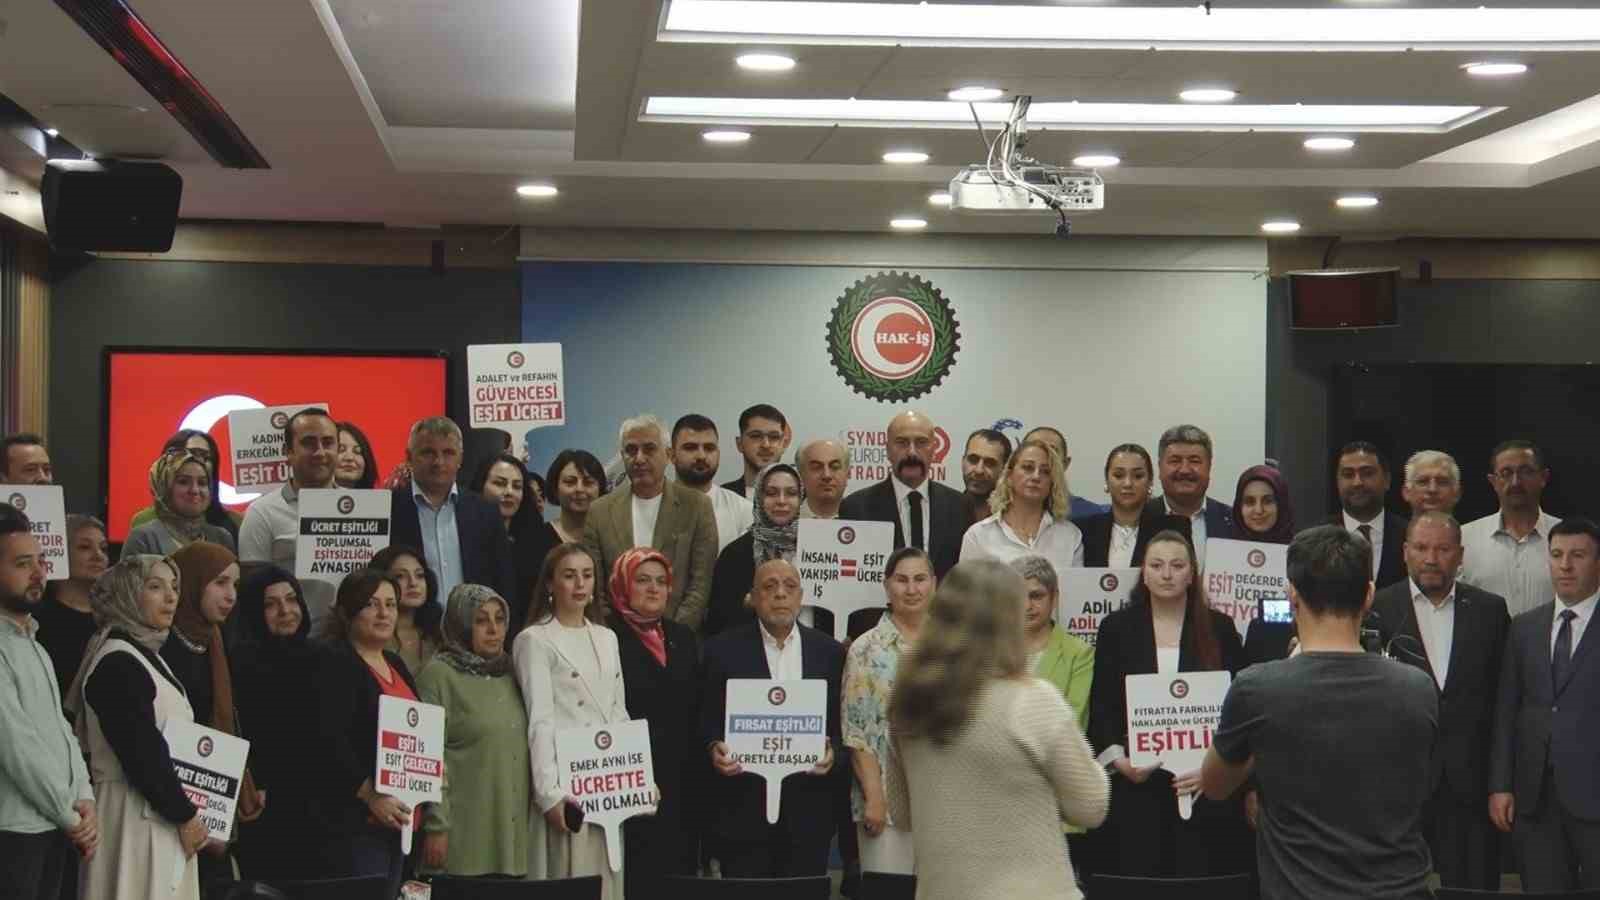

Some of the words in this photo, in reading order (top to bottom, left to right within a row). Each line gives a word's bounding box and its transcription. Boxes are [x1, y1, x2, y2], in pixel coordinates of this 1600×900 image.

[876, 331, 929, 346] HAK-İŞ
[476, 374, 507, 383] ADALET
[476, 383, 557, 401] GÜVENCESİ
[511, 403, 560, 420] ÜCRET
[237, 446, 279, 459] ERKEĞİN
[239, 464, 274, 484] EŞİT
[848, 465, 892, 480] TRAD
[311, 520, 340, 533] ÜCRET
[342, 519, 379, 534] EŞİTLİĞİ
[316, 537, 372, 547] TOPLUMSAL
[801, 549, 839, 564] İNSANA
[863, 551, 885, 567] EŞİT
[800, 567, 839, 582] YAKIŞIR
[857, 567, 883, 582] ÜCRE
[814, 582, 823, 598] İŞ
[1208, 571, 1232, 597] EŞİT
[1236, 573, 1284, 587] DEĞERDE
[1134, 706, 1177, 716] FITRATTA
[735, 718, 773, 731] FIRSAT
[775, 717, 820, 732] EŞİTLİĞİ
[1132, 719, 1178, 727] HAKLARDA
[763, 735, 792, 752] EŞİT
[1137, 725, 1210, 756] EŞİTLİ
[570, 759, 599, 772] EMEK
[602, 756, 626, 768] AYNI
[628, 752, 644, 764] İSE
[731, 752, 775, 764] ÜCRETLE
[778, 753, 818, 766] BAŞLAR
[408, 778, 433, 792] ÜCRET
[571, 770, 646, 796] ÜCRETTE
[577, 798, 600, 813] YNI
